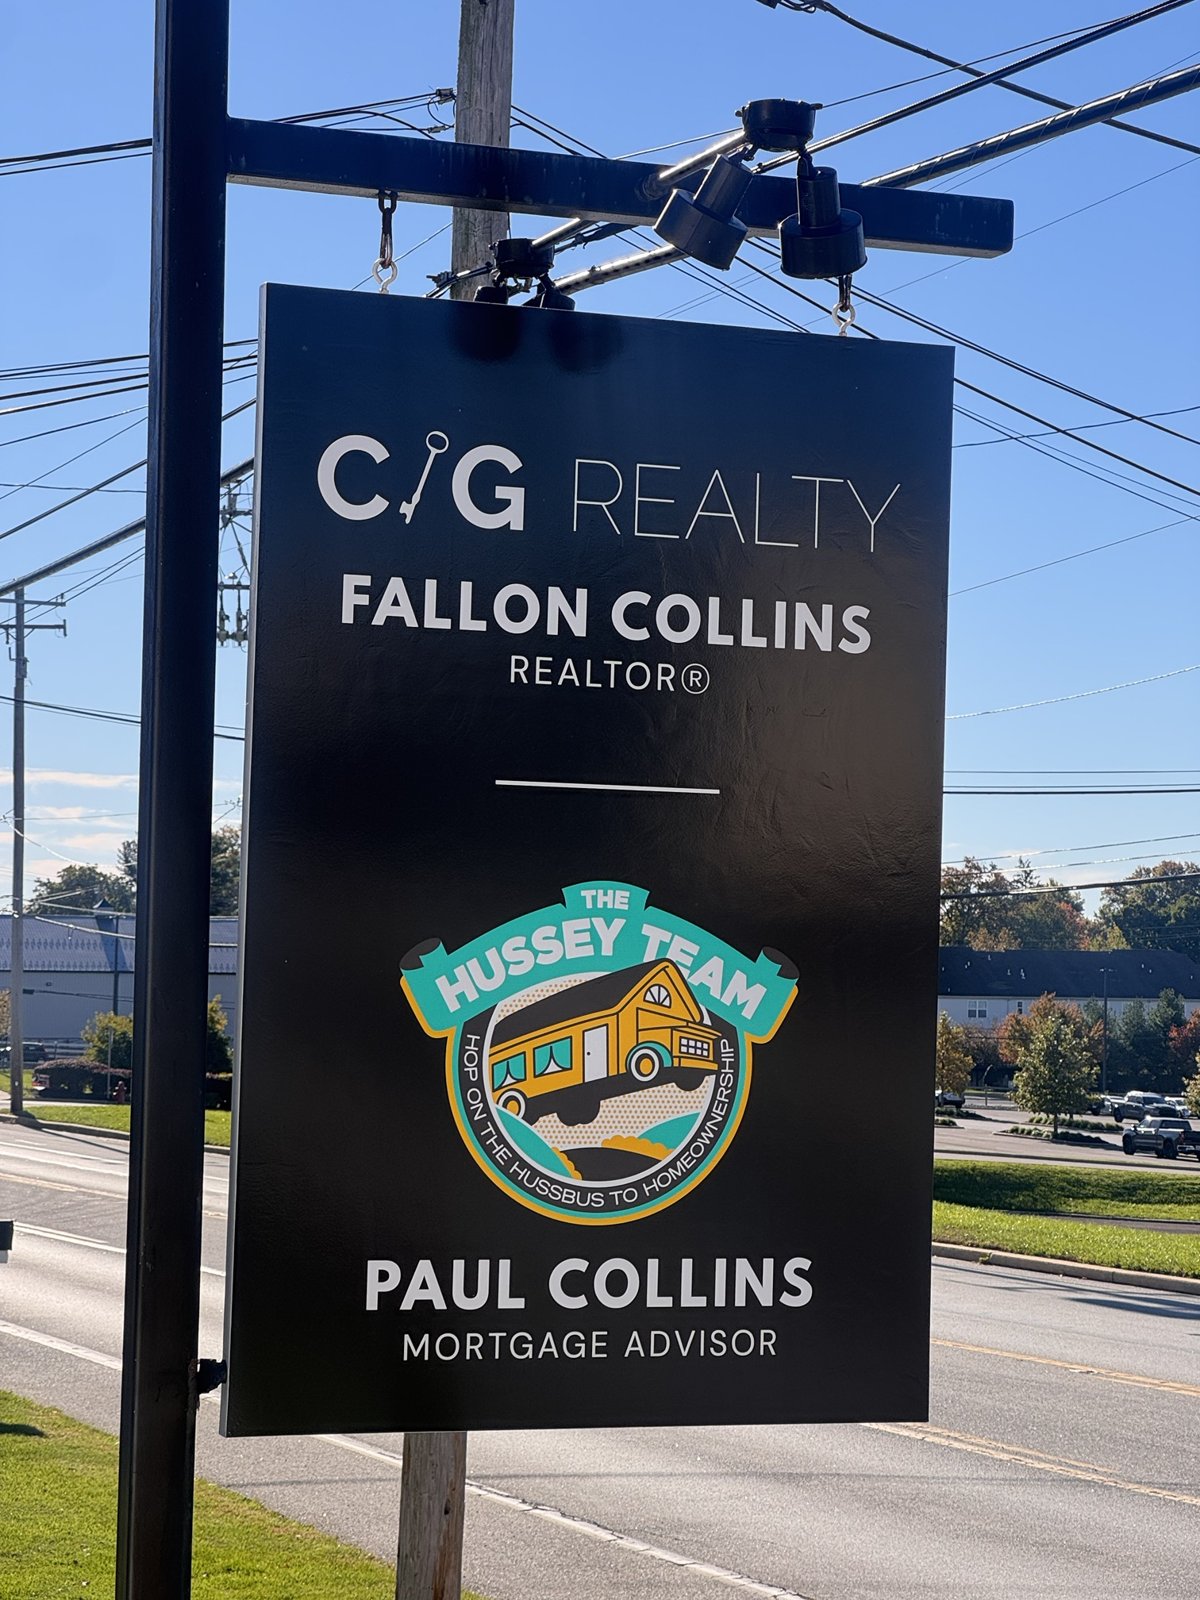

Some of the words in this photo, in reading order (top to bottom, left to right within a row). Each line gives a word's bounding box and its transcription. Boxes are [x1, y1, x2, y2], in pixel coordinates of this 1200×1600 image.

[573, 458, 901, 553] REALTY
[341, 573, 588, 638] FALLON
[611, 590, 871, 655] COLLINS
[580, 889, 630, 910] THE
[435, 917, 626, 1013] HUSSEY
[641, 923, 767, 1020] TEAM
[463, 1034, 481, 1082] HOP
[466, 1087, 487, 1121] ON
[642, 1038, 735, 1197] HOMEOWNERSHIP
[480, 1121, 513, 1166] THE
[509, 1161, 605, 1208] HUSSBUS
[608, 1187, 638, 1206] TO
[365, 1259, 526, 1311] PAUL
[548, 1257, 813, 1310] COLLINS
[403, 1331, 608, 1361] MORTGAGE
[624, 1329, 777, 1358] ADVISOR
